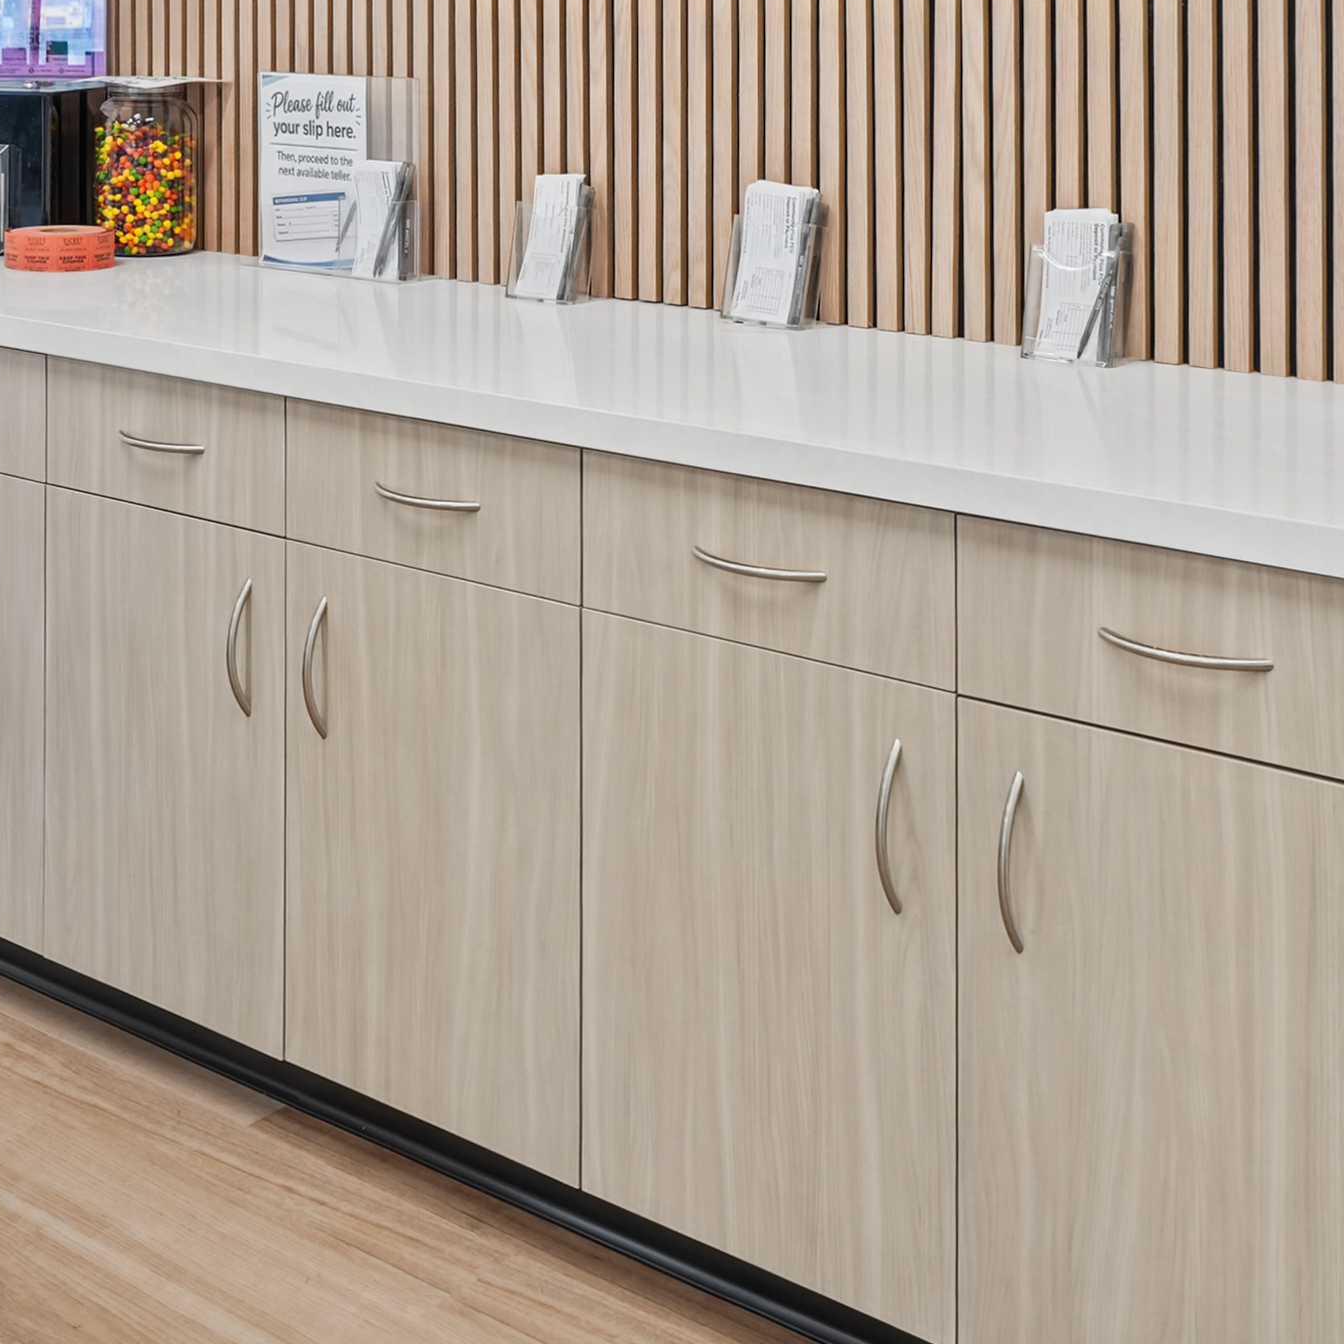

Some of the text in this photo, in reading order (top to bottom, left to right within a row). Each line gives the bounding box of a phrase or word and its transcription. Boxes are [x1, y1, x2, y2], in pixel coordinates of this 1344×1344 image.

[271, 90, 356, 120] Please fill out
[273, 119, 356, 140] your slip here.
[277, 150, 353, 167] Then, proceed to the
[278, 167, 352, 182] next available teller.
